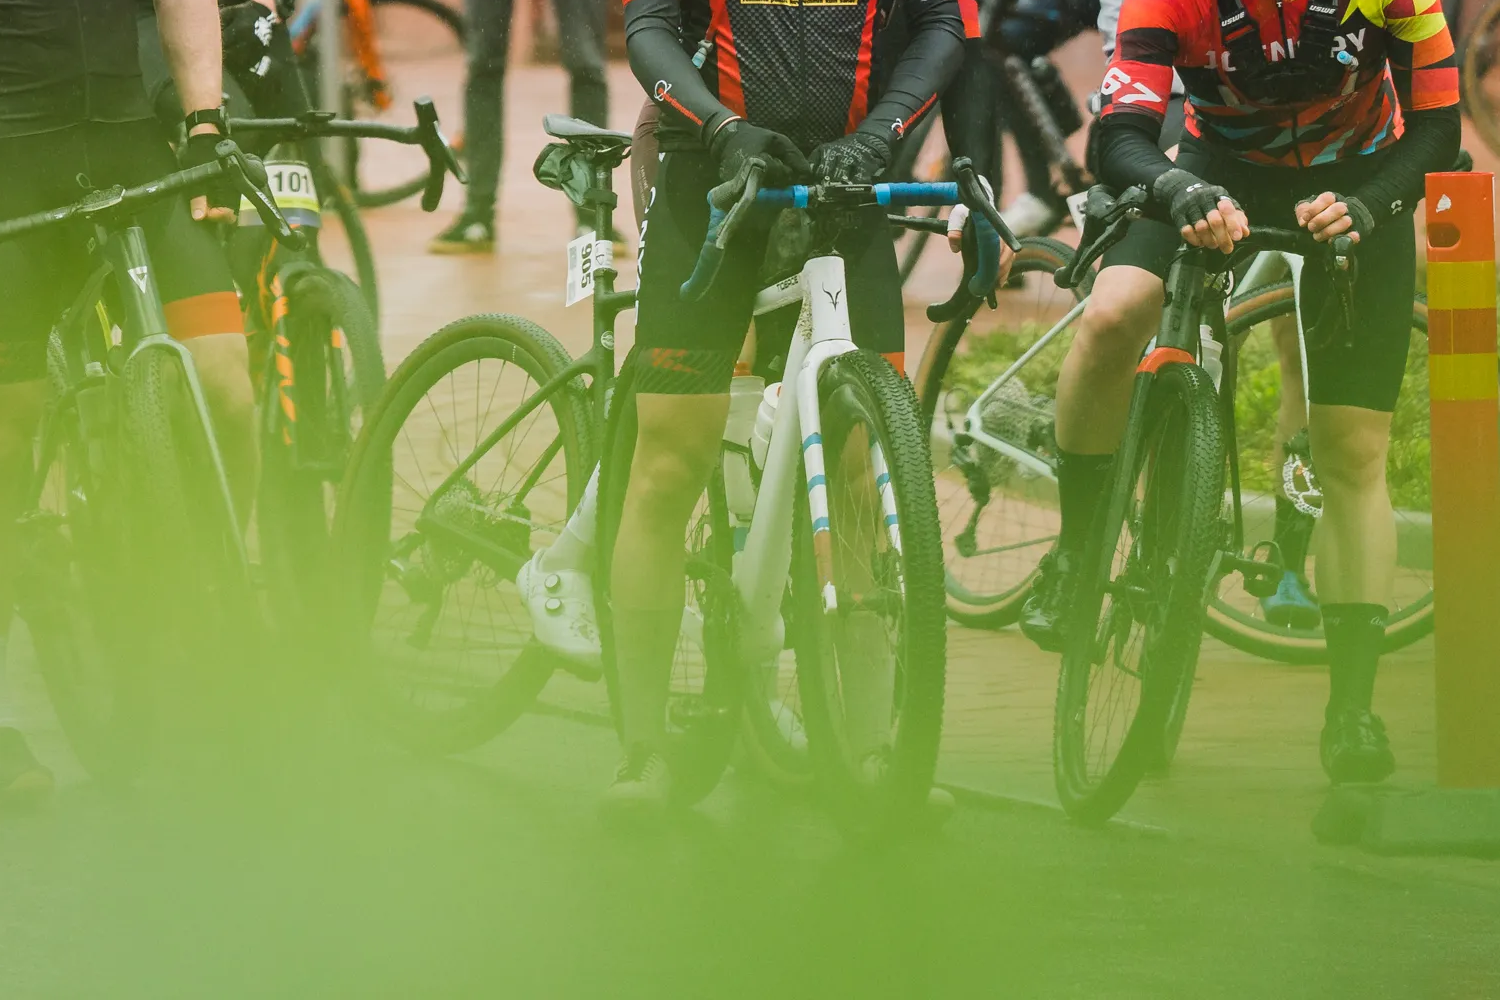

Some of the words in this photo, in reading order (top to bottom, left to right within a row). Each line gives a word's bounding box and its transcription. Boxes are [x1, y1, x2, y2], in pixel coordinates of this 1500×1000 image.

[1309, 4, 1336, 15] USWE
[1221, 11, 1245, 27] USWE
[581, 243, 593, 288] 905
